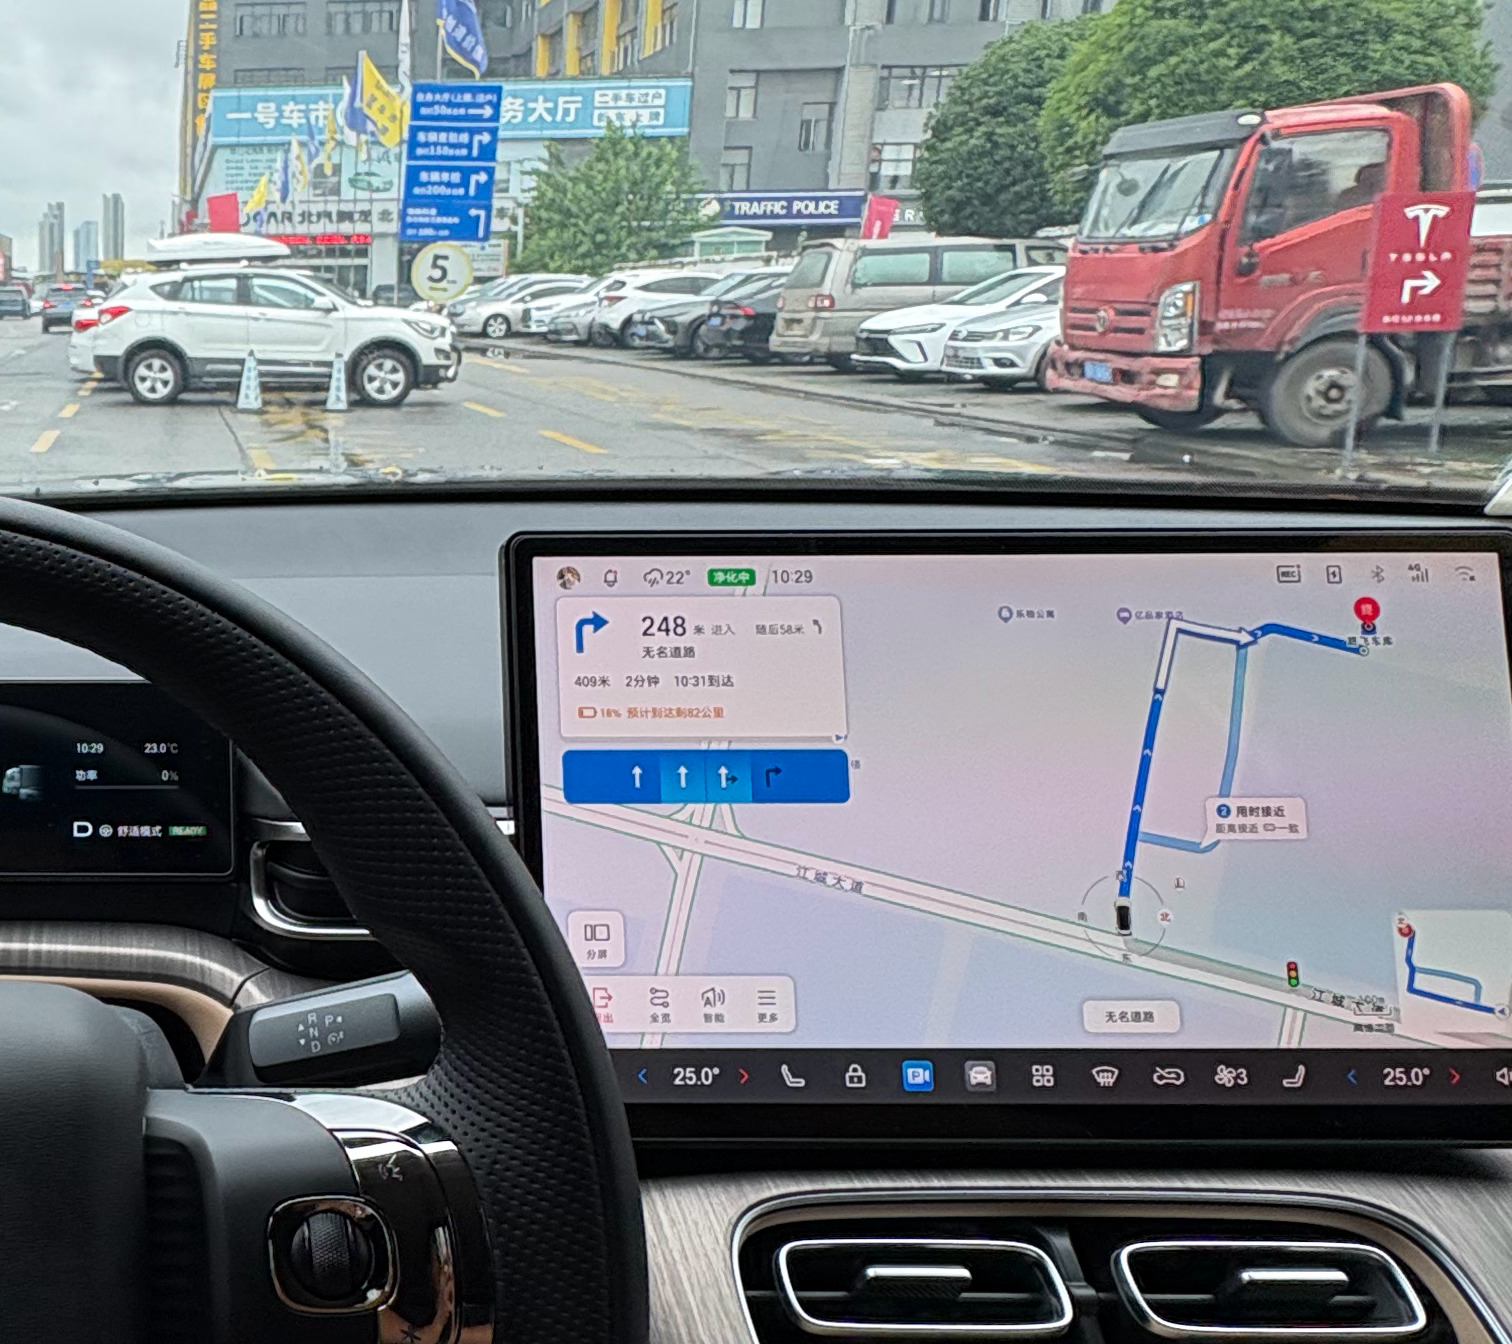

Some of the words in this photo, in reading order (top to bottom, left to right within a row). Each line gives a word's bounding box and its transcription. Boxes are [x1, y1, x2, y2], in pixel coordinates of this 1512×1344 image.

[733, 201, 787, 216] TRAFFIC
[792, 199, 840, 214] POLICE
[427, 254, 450, 284] 5
[772, 569, 813, 584] 10:29
[641, 616, 687, 637] 248
[642, 646, 695, 659] 无名道路
[574, 674, 611, 688] 409米
[625, 674, 660, 688] 2分钟
[674, 674, 735, 688] 10:31到达
[73, 822, 93, 837] D
[324, 1015, 334, 1027] P
[757, 1012, 779, 1024] 更多
[310, 1040, 321, 1054] D
